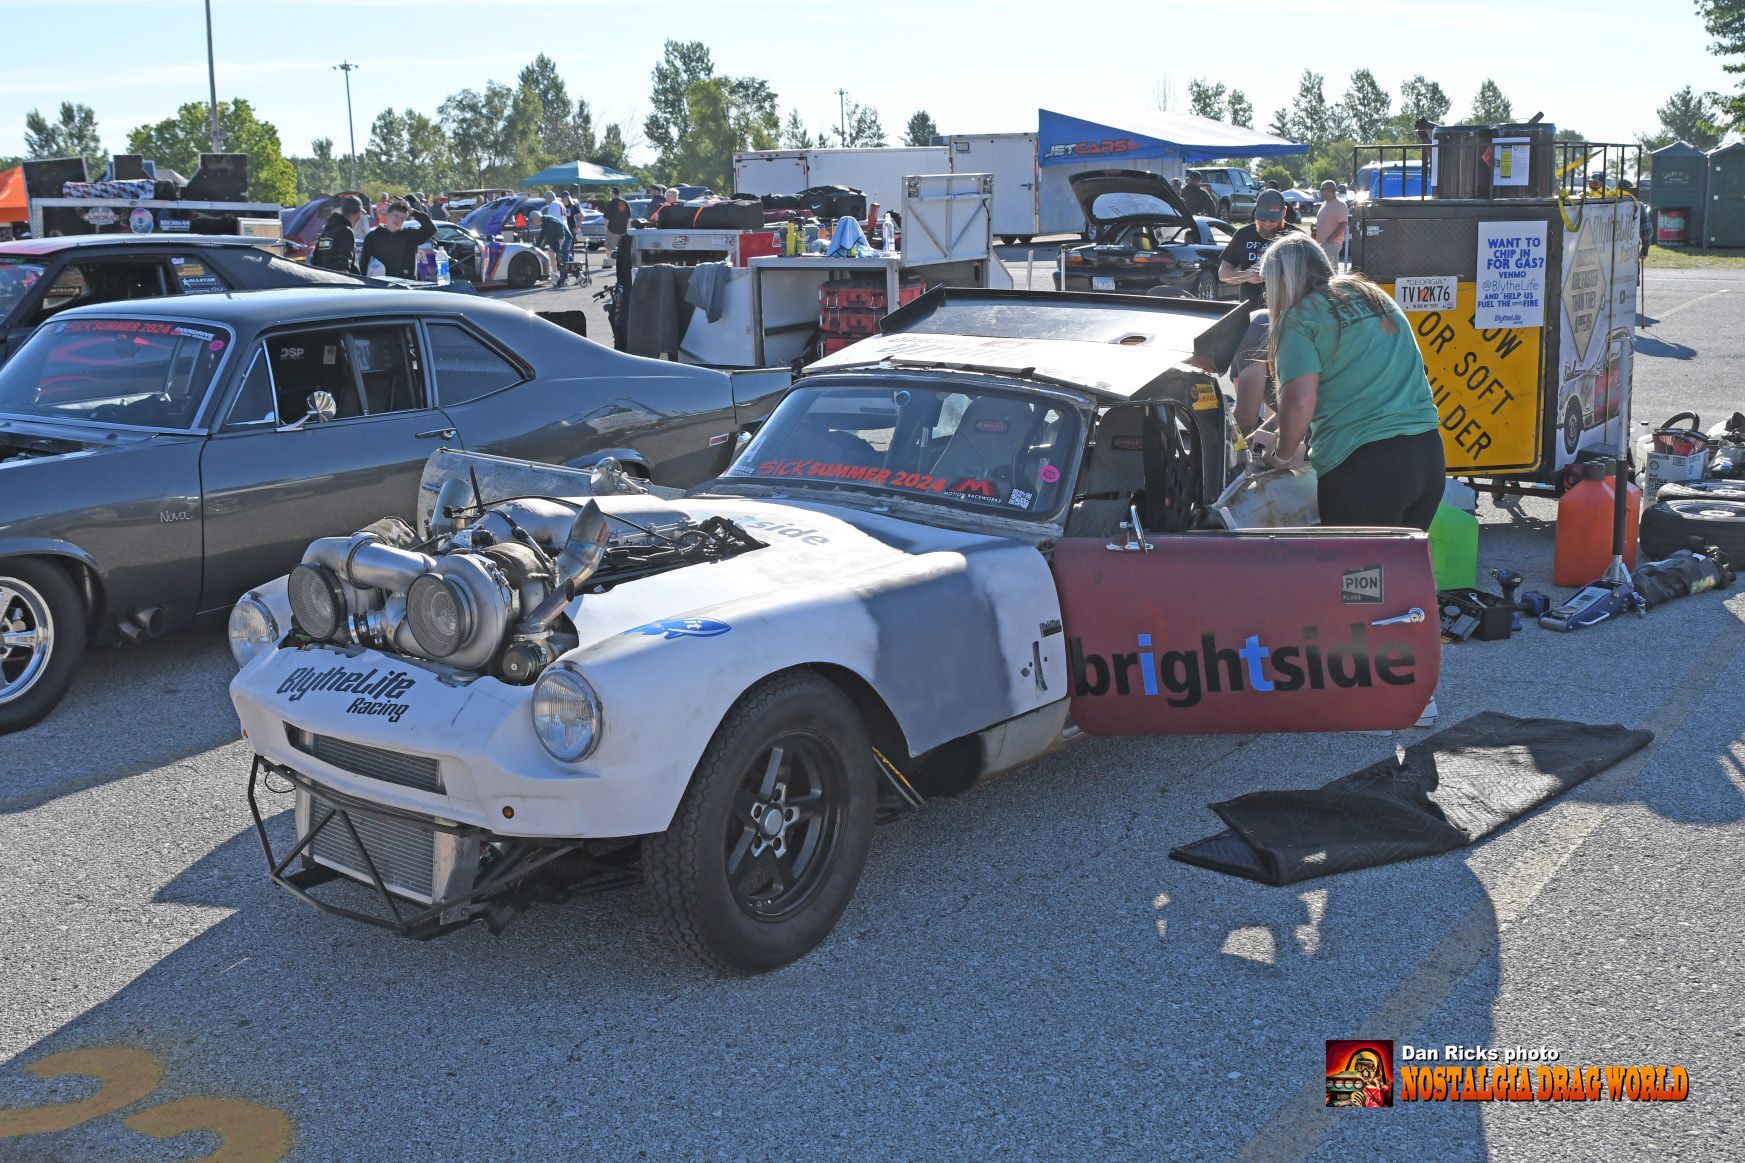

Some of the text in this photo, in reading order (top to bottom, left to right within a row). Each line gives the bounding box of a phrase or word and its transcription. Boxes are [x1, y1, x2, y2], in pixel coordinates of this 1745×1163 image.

[1045, 141, 1128, 158] JETCARS
[1488, 237, 1540, 248] WANT TO
[1493, 249, 1530, 259] CHIP IN
[1487, 257, 1545, 269] FOR GAS?
[1499, 271, 1527, 279] VENMO
[1401, 285, 1450, 302] TV12K76
[140, 322, 173, 335] 2024
[1417, 311, 1455, 355] OR
[1453, 351, 1515, 415] SOFT
[759, 460, 947, 493] SICK SUMMER 2024
[943, 490, 1002, 504] MOTION RACEWORKS
[160, 510, 193, 523] Nova
[1346, 576, 1379, 590] PION
[1068, 623, 1416, 708] brightside
[276, 666, 416, 701] BlytheLife
[346, 697, 410, 723] Racing
